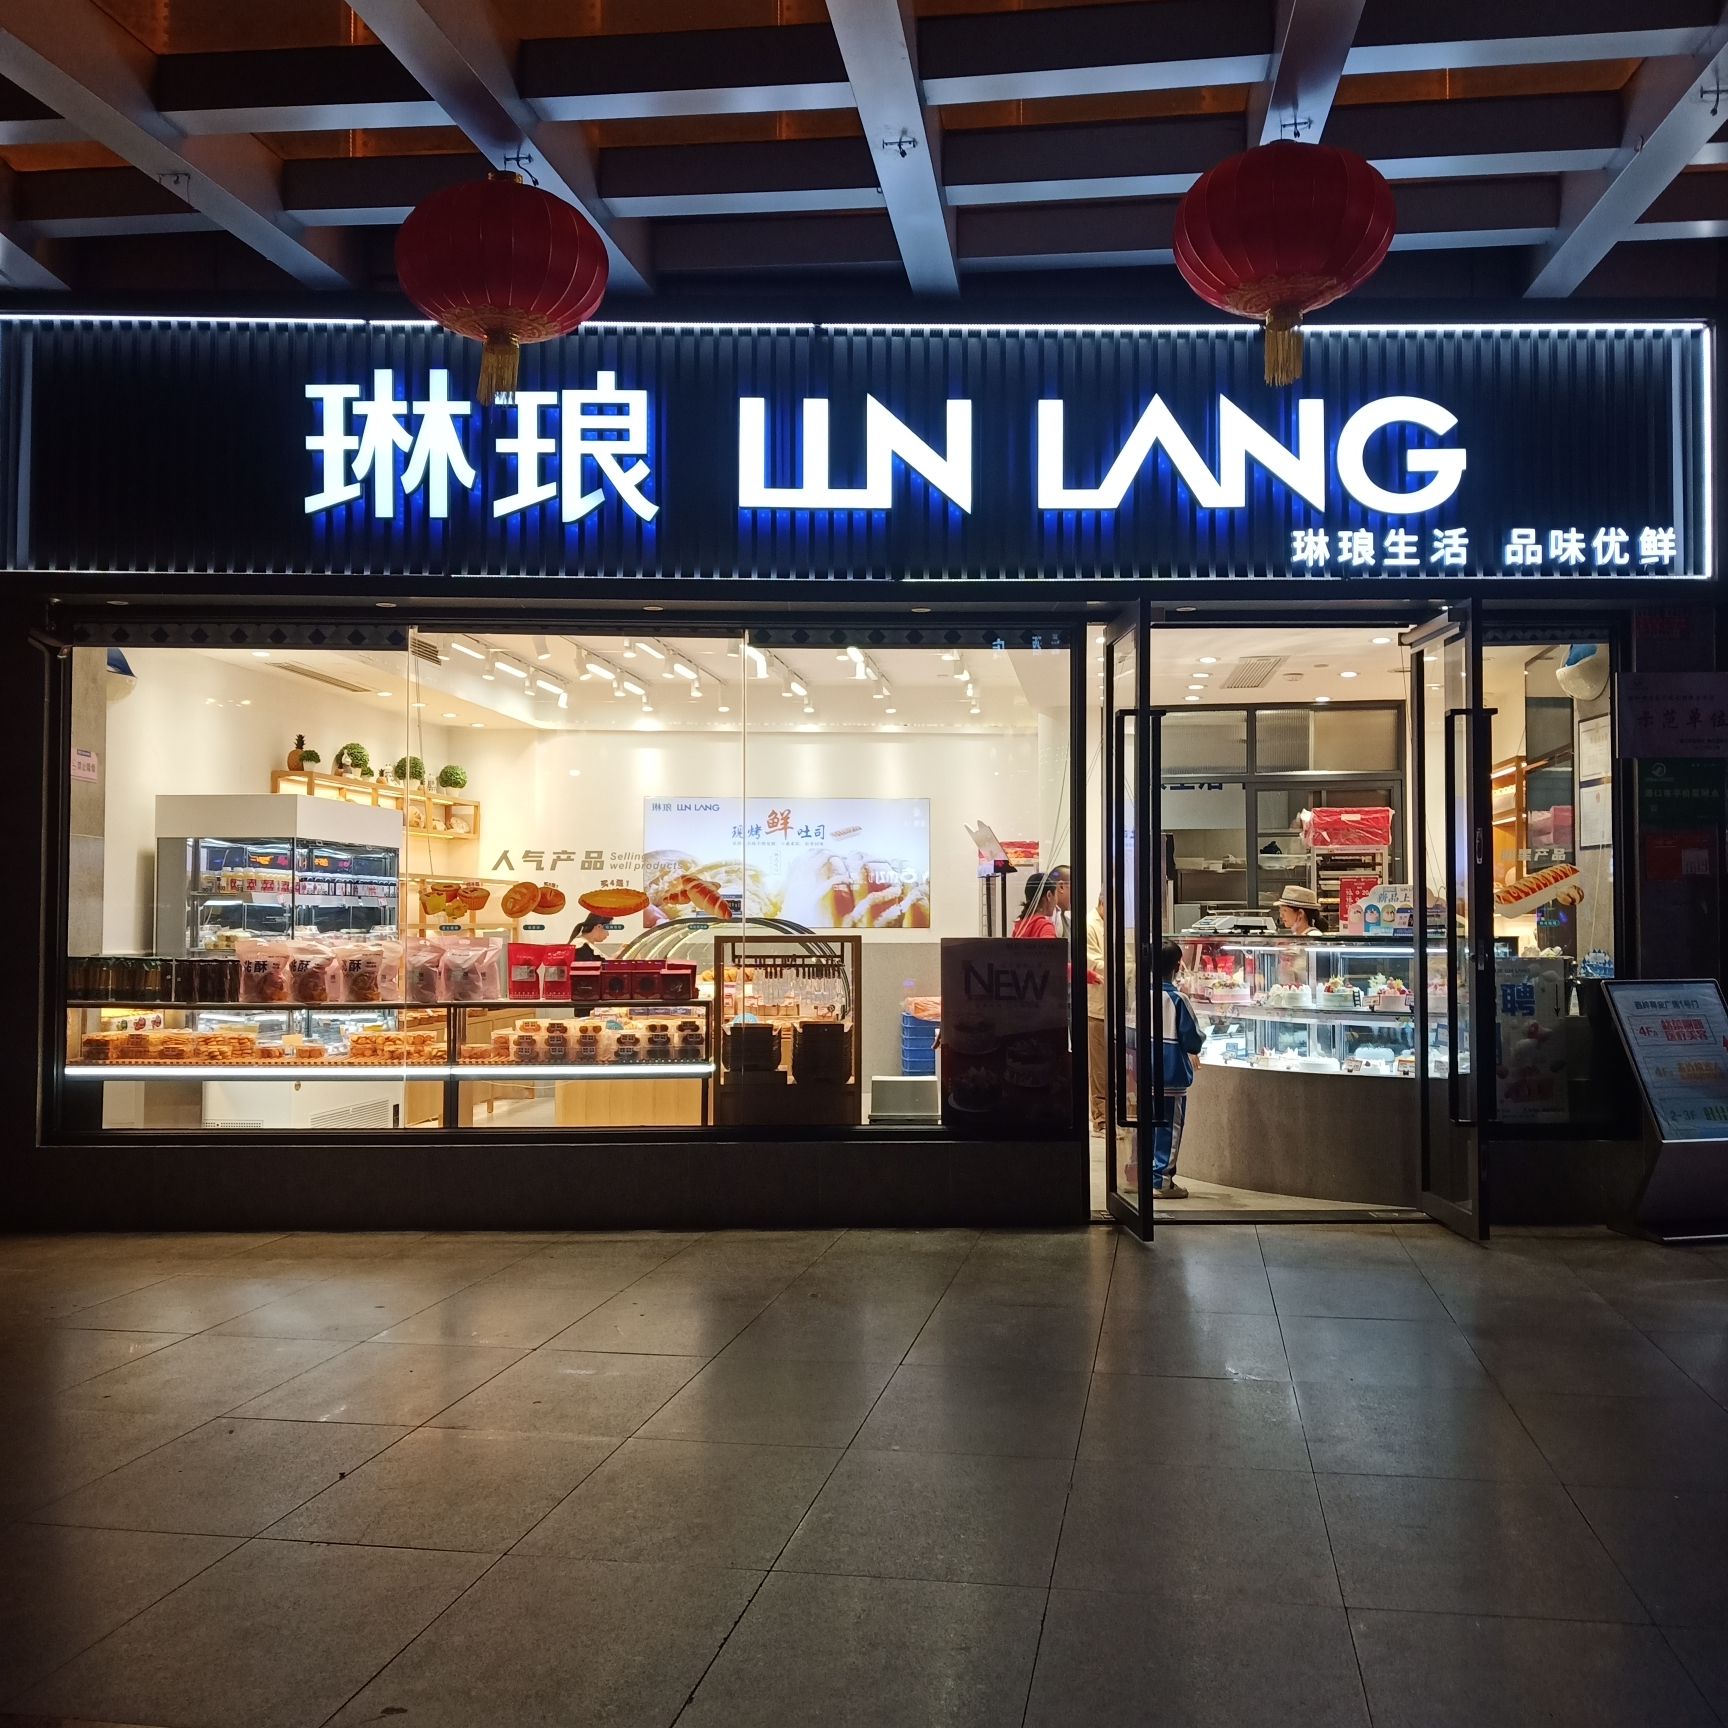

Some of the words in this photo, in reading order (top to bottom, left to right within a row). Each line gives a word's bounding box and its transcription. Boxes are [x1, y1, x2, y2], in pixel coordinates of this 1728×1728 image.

[305, 368, 661, 523] 琳琅
[738, 393, 972, 515] LIN
[1037, 393, 1467, 515] LANG
[1291, 527, 1469, 567] 琳琅生活
[1505, 527, 1677, 567] 品味优鲜
[694, 803, 720, 811] LANG
[492, 850, 605, 871] 人气产品
[610, 852, 648, 862] Selling
[610, 862, 632, 870] well
[634, 862, 684, 872] products
[964, 960, 1050, 1001] NEW
